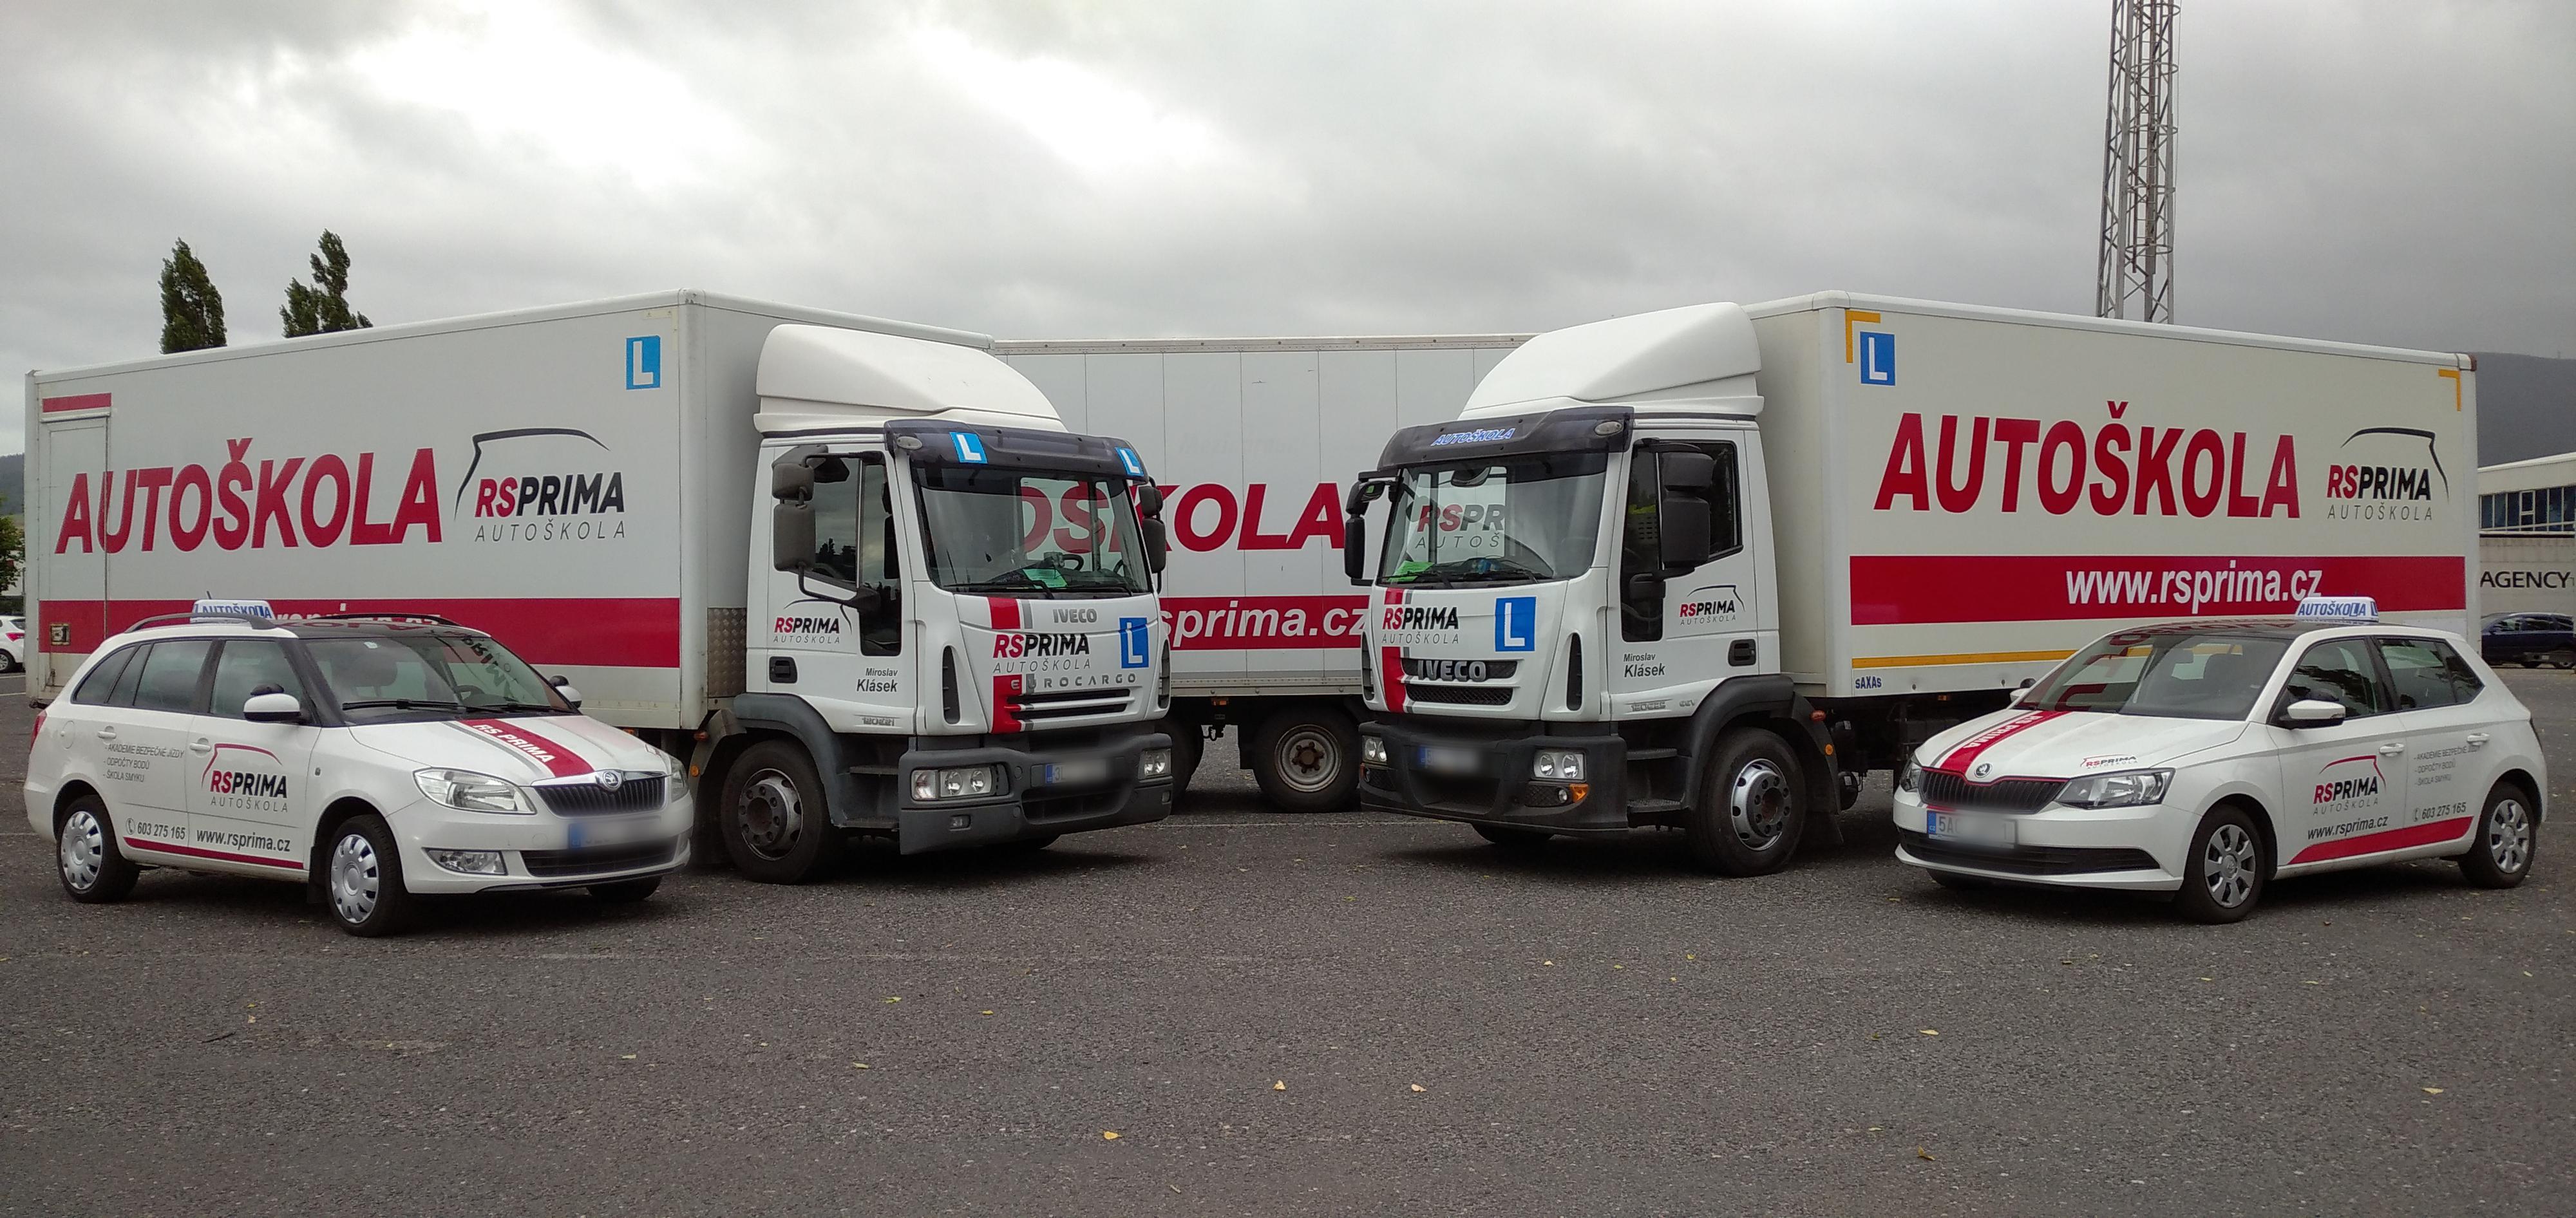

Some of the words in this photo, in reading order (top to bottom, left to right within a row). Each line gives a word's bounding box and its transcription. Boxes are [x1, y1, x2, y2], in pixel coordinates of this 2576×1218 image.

[633, 341, 654, 386] L
[1868, 336, 1888, 380] L
[1431, 427, 1515, 446] AUTOŠKOLA
[1873, 400, 2300, 519] AUTOŠKOLA
[2326, 464, 2431, 501] RSPRIMA
[55, 437, 442, 554] AUTOŠKOLA
[474, 471, 625, 518] RSPRIMA
[2327, 501, 2432, 521] AUTOŠKOLA
[474, 518, 625, 542] AUTOŠKOLA
[2065, 559, 2323, 614] www.rsprima.cz
[2479, 570, 2571, 588] AGENCY
[1052, 608, 1097, 623] IVECO
[1382, 606, 1459, 630] RSPRIMA
[1680, 600, 1736, 618] RSPRIMA
[2297, 600, 2367, 617] AUTOŠKOLA
[774, 617, 840, 634] RSPRIMA
[1504, 602, 1526, 647] L
[1680, 615, 1736, 626] AUTOŠKOLA
[773, 635, 840, 644] AUTOŠKOLA
[992, 633, 1090, 659] RSPRIMA
[1381, 631, 1459, 644] AUTOŠKOLA
[993, 657, 1091, 673] AUTOŠKOLA
[1623, 652, 1656, 662] Miroslav
[865, 667, 898, 677] Miroslav
[1417, 659, 1487, 682] IVECO
[1624, 662, 1665, 678] Klásek
[857, 679, 898, 693] Klásek
[1010, 673, 1137, 690] EUROCARGO
[1855, 676, 1882, 689] SAXAS
[472, 724, 503, 736] RS
[497, 733, 556, 763] PRIMA
[2086, 756, 2137, 767] RSPRIMA
[210, 770, 288, 799] RSPRIMA
[2313, 776, 2378, 804] RSPRIMA
[211, 796, 289, 813] AUTOŠKOLA
[2313, 797, 2379, 816] AUTOŠKOLA
[2421, 807, 2436, 820] 603
[2436, 804, 2450, 818] 275
[2452, 801, 2467, 814] 165
[137, 821, 152, 836] 603
[153, 823, 169, 838] 275
[171, 825, 186, 839] 165
[2307, 816, 2389, 840] www.rsprima.cz
[196, 829, 291, 852] www.rsprima.cz
